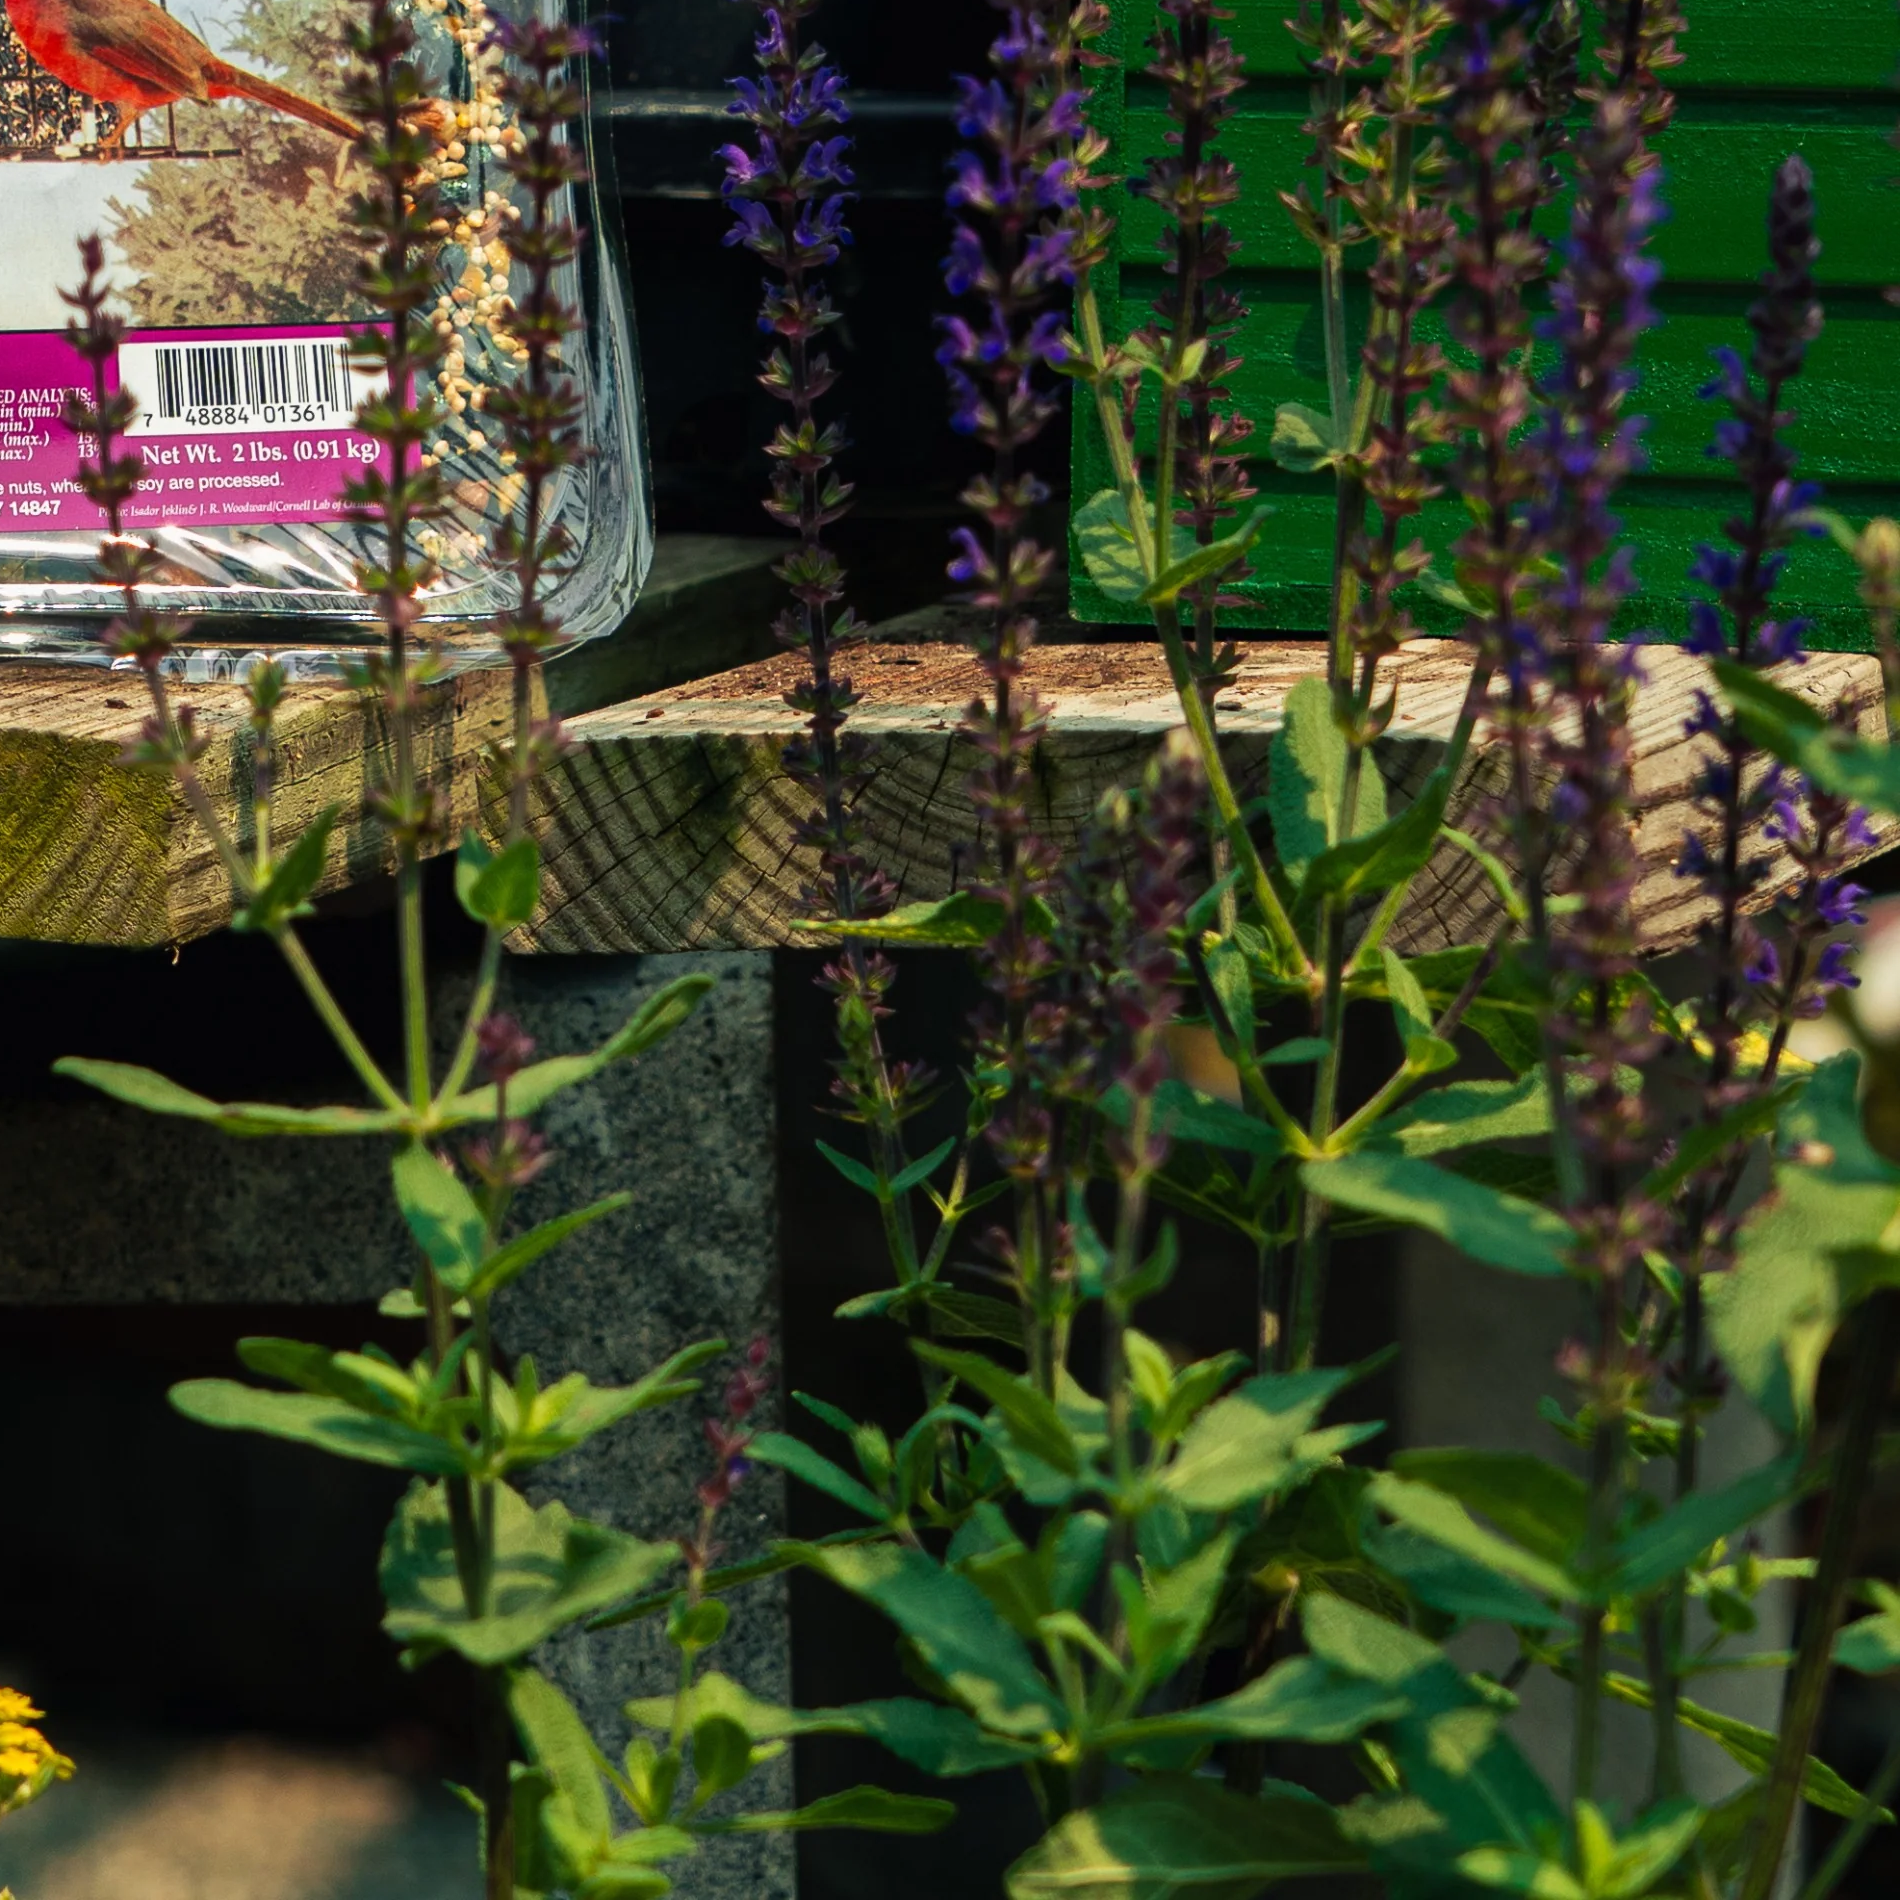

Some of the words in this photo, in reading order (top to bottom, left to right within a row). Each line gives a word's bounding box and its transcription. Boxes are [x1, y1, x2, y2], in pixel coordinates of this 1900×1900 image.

[20, 387, 92, 403] ANALYIS:
[18, 403, 61, 418] (min.)
[143, 413, 153, 428] 7
[185, 406, 249, 426] 48884
[264, 404, 326, 423] 01361
[3, 432, 49, 447] (max.)
[141, 445, 180, 465] Net
[184, 444, 222, 464] Wt.
[232, 444, 245, 462] 2
[250, 441, 287, 462] lbs.
[293, 440, 340, 462] (0.91
[346, 438, 380, 464] kg)
[9, 480, 46, 496] nuts,
[137, 476, 164, 493] soy
[169, 476, 193, 490] are
[198, 471, 284, 492] processed.
[9, 500, 61, 515] 14847
[313, 499, 330, 511] Lab
